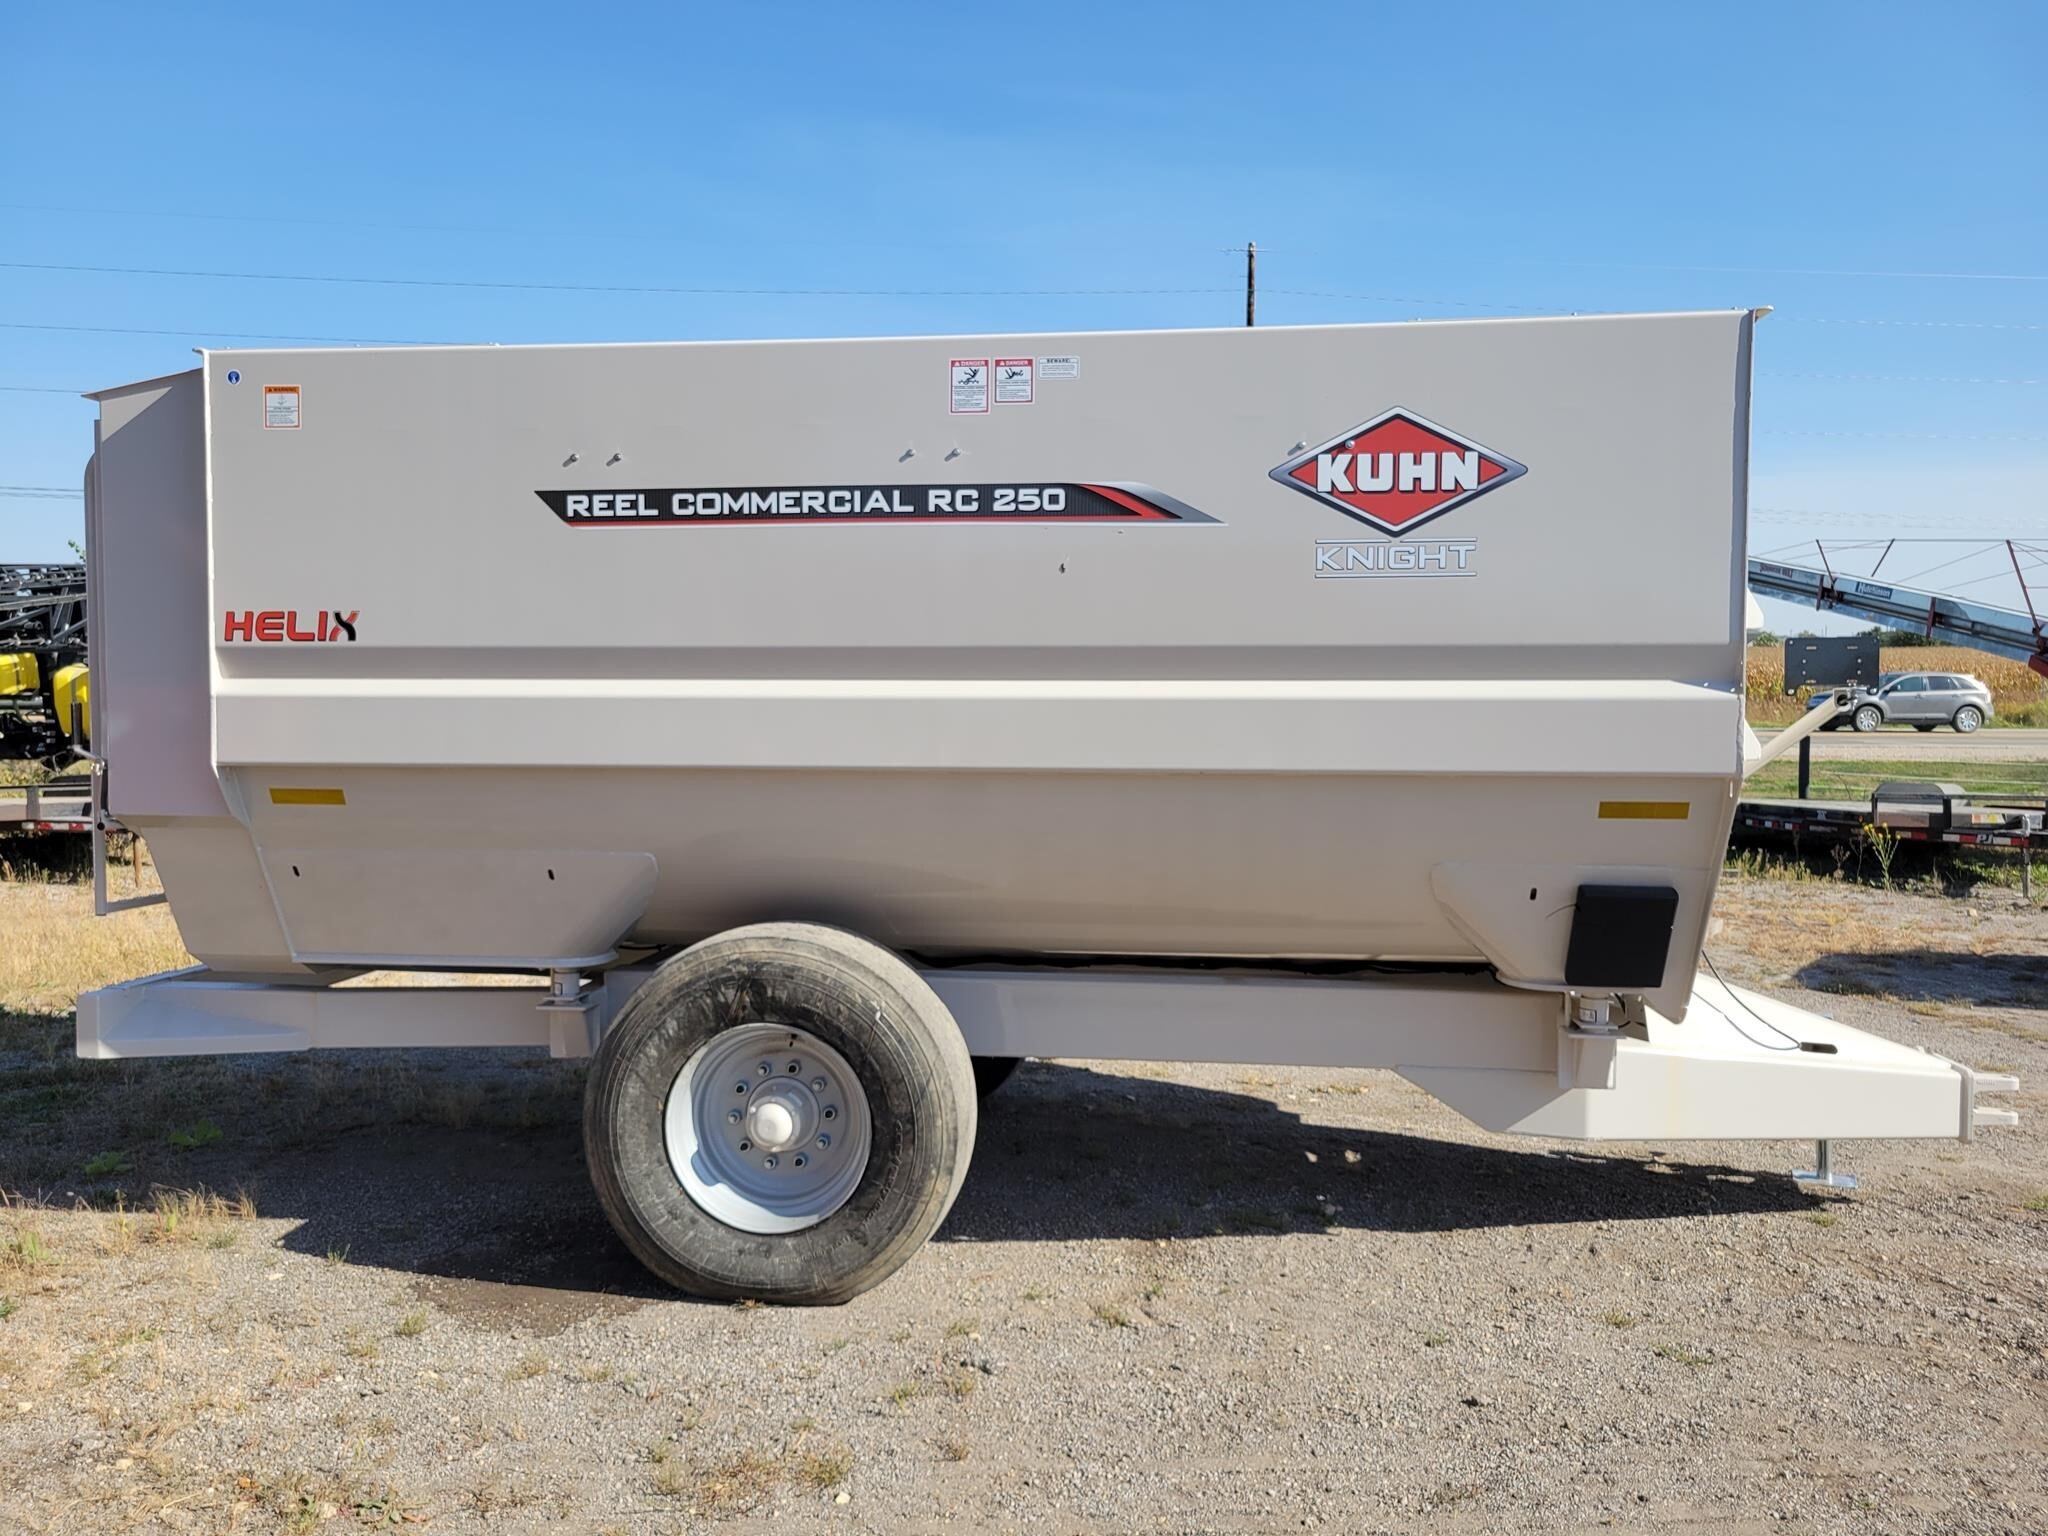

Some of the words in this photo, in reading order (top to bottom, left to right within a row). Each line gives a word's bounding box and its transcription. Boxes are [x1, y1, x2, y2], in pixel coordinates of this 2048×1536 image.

[1316, 451, 1479, 492] KUHN
[566, 494, 659, 517] REEL
[671, 489, 914, 516] COMMERCIAL
[928, 489, 979, 512] RC
[993, 487, 1066, 512] 250
[1315, 545, 1476, 570] KNIGHT
[1858, 582, 1891, 598] Hutchinson
[224, 610, 360, 642] HELIX
